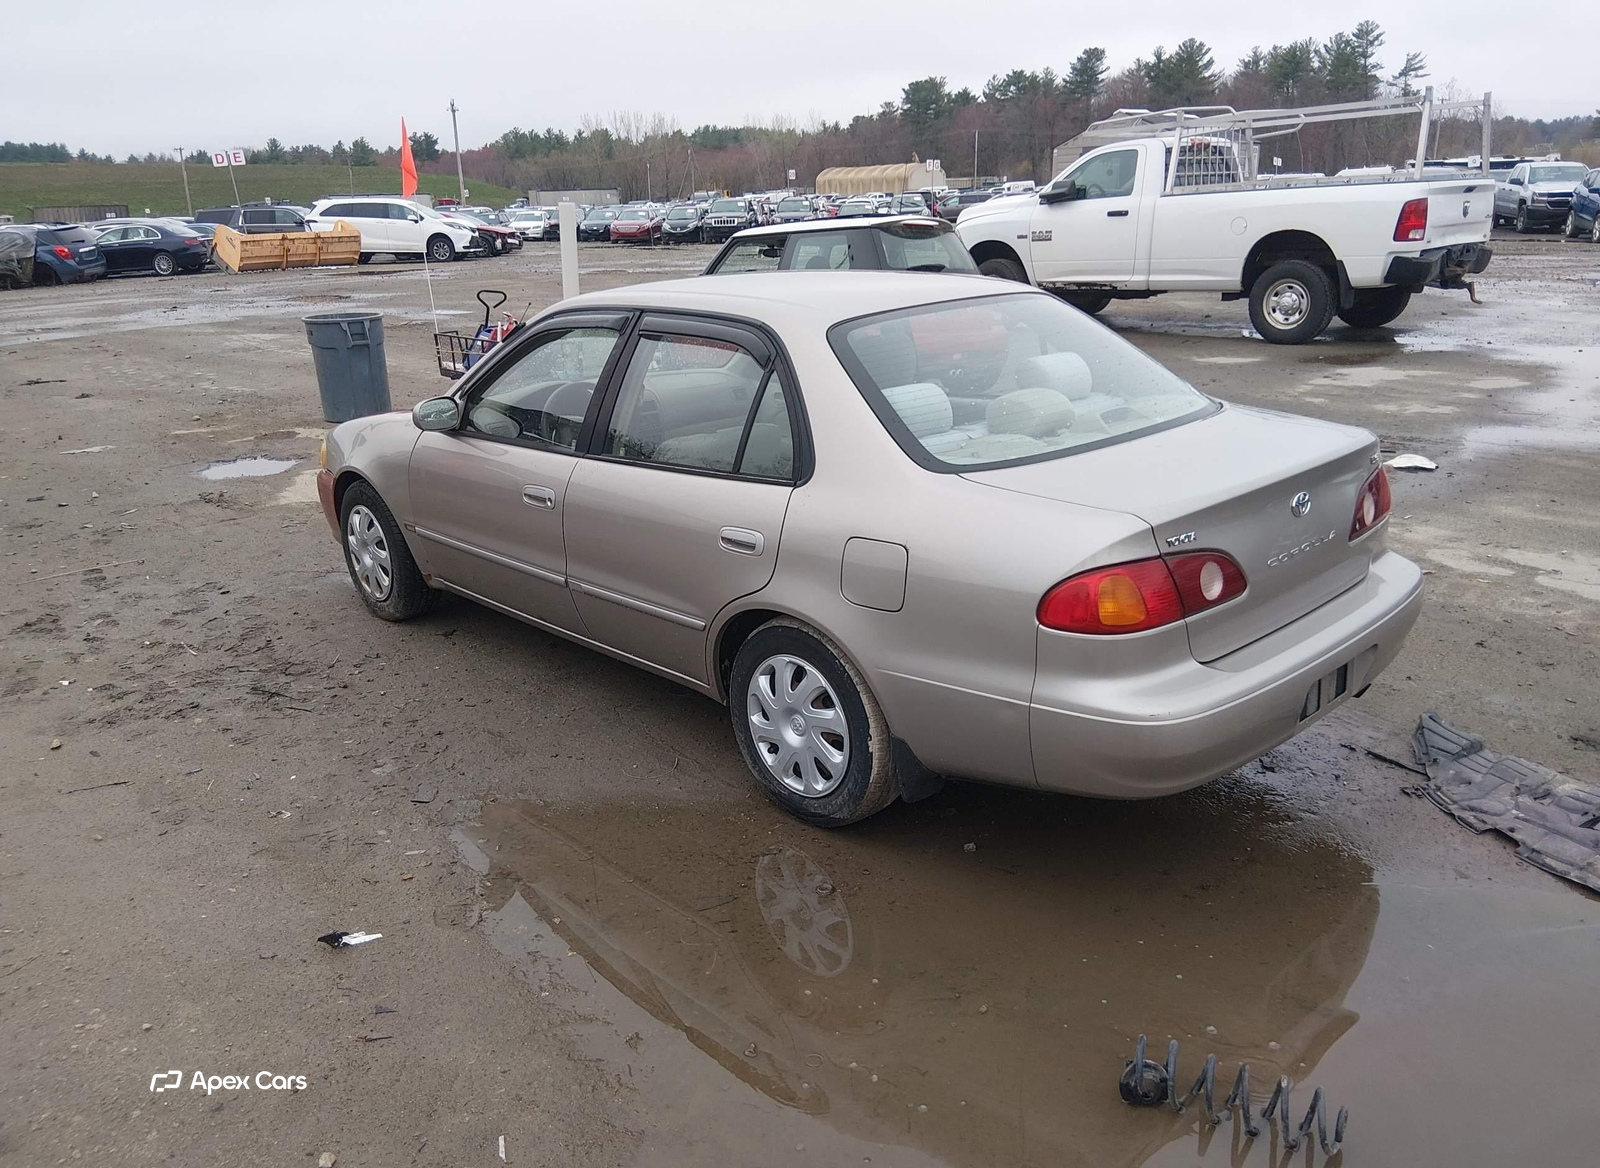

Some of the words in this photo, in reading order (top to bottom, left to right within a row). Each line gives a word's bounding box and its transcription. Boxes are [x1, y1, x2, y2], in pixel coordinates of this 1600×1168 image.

[214, 153, 225, 164] D
[232, 152, 242, 163] E
[1165, 531, 1196, 547] TOYOTA
[1267, 529, 1337, 567] COROLLA
